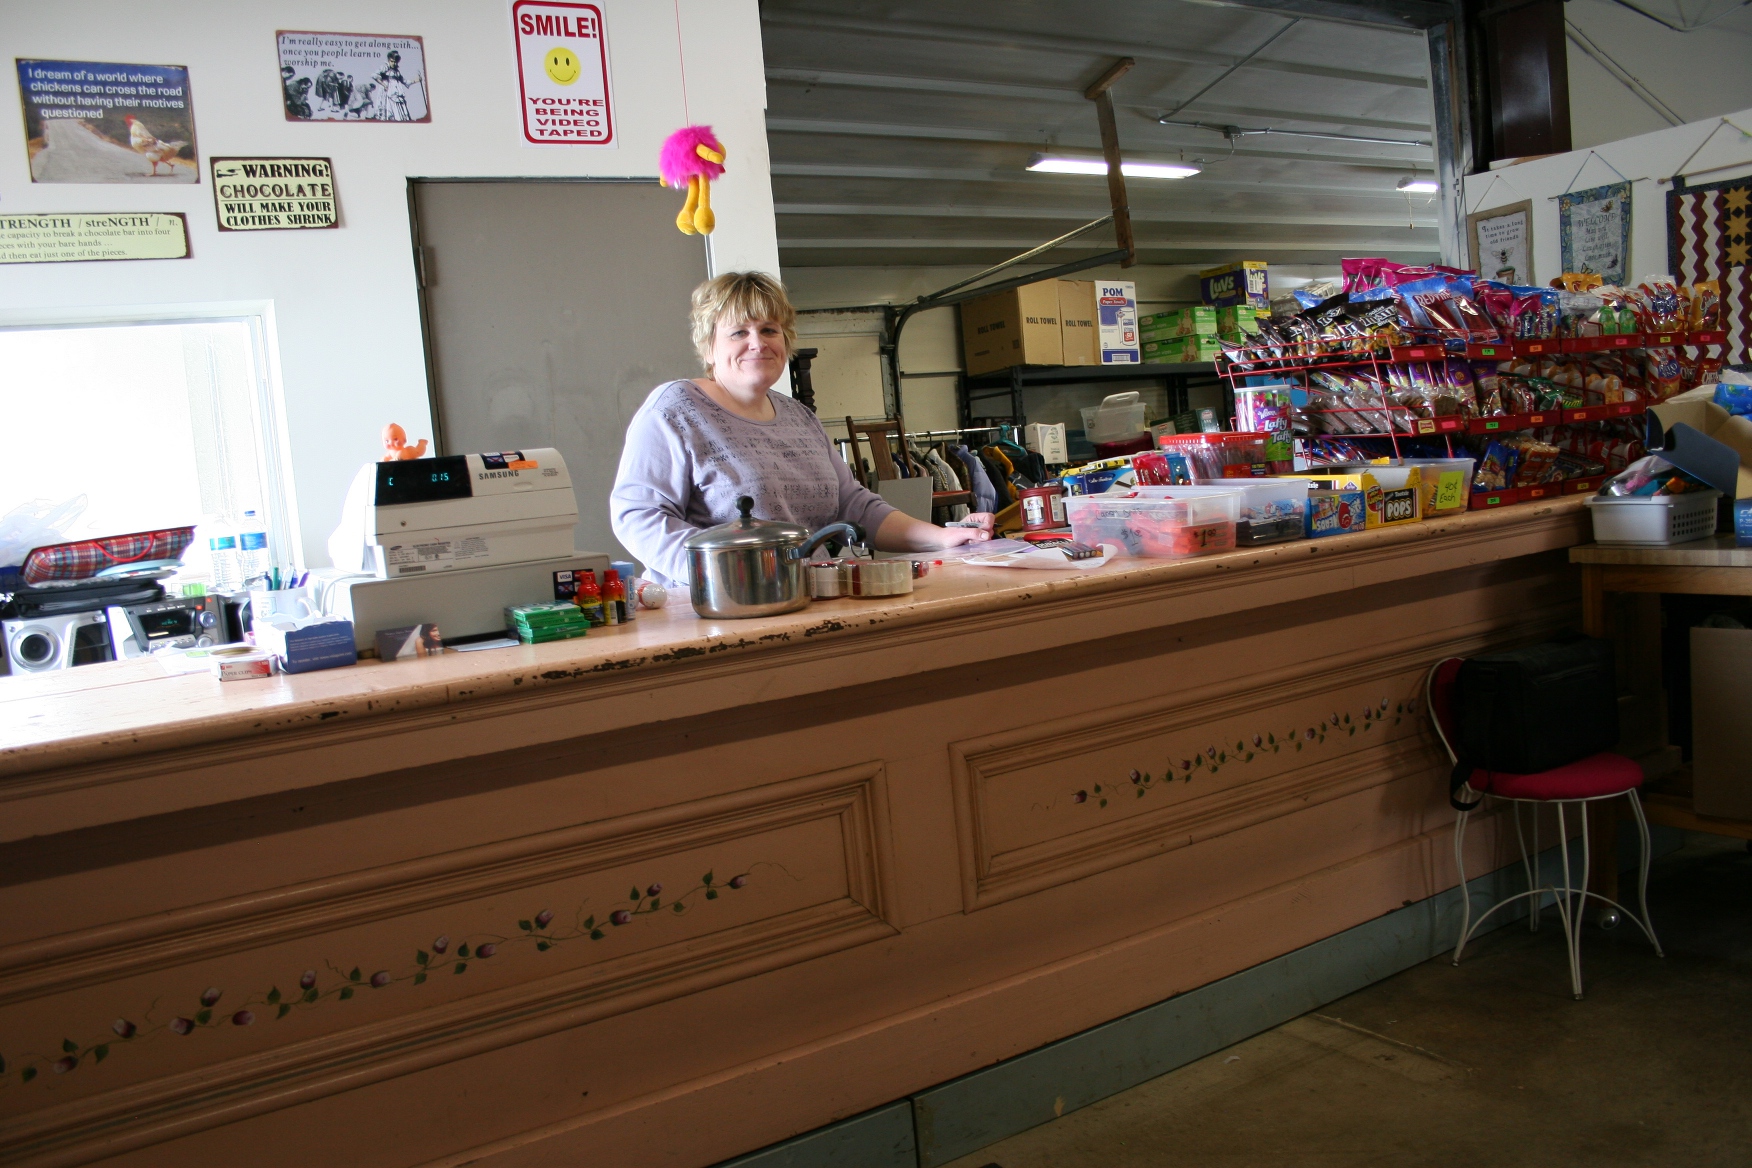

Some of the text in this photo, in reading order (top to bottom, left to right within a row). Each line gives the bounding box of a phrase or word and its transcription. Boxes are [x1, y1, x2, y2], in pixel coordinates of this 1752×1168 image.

[520, 13, 597, 38] SMILE!
[281, 36, 297, 45] I'm
[298, 37, 324, 47] really
[324, 40, 344, 48] easy
[345, 39, 352, 47] to
[354, 40, 367, 49] get
[368, 39, 392, 50] along
[303, 50, 319, 58] you
[321, 49, 348, 59] people
[350, 48, 372, 58] learn
[373, 50, 381, 58] to
[283, 58, 335, 68] worship me.
[28, 68, 33, 78] I
[34, 69, 72, 80] dream
[73, 70, 87, 80] of
[96, 72, 127, 82] world
[129, 73, 164, 83] where
[30, 82, 183, 96] chickens can cross the road
[31, 94, 184, 109] without having their motives
[528, 97, 604, 107] YOU'RE
[41, 107, 104, 119] questioned
[535, 108, 600, 117] BEING
[536, 118, 600, 127] VIDEO
[535, 128, 603, 138] TAPED
[242, 164, 330, 178] WARNING!
[220, 183, 332, 198] CHOCOLATE
[224, 201, 332, 214] WILL MAKE YOUR
[0, 218, 71, 229] TRENGTH
[226, 214, 332, 226] CLOTHES SHRINK
[1511, 219, 1524, 229] long
[7, 231, 41, 240] capacity
[1500, 234, 1519, 242] friends
[1506, 228, 1519, 237] grow
[0, 241, 15, 249] eces
[17, 241, 35, 249] with
[38, 242, 56, 250] your
[58, 240, 76, 248] bare
[78, 239, 102, 247] hands
[9, 251, 27, 259] then
[43, 251, 58, 259] just
[88, 249, 100, 257] the
[102, 249, 128, 258] pieces.
[1102, 288, 1124, 297] POM
[1209, 275, 1235, 300] Luvs
[977, 320, 1005, 334] ROLL TOWEL
[1026, 317, 1057, 326] ROLL TOWEL
[1077, 320, 1093, 328] TOWEL
[1264, 418, 1288, 432] Laffy
[1271, 431, 1292, 444] Taffy
[478, 470, 520, 481] SAMSUNG
[1440, 493, 1456, 504] Each
[1387, 500, 1411, 518] POPS
